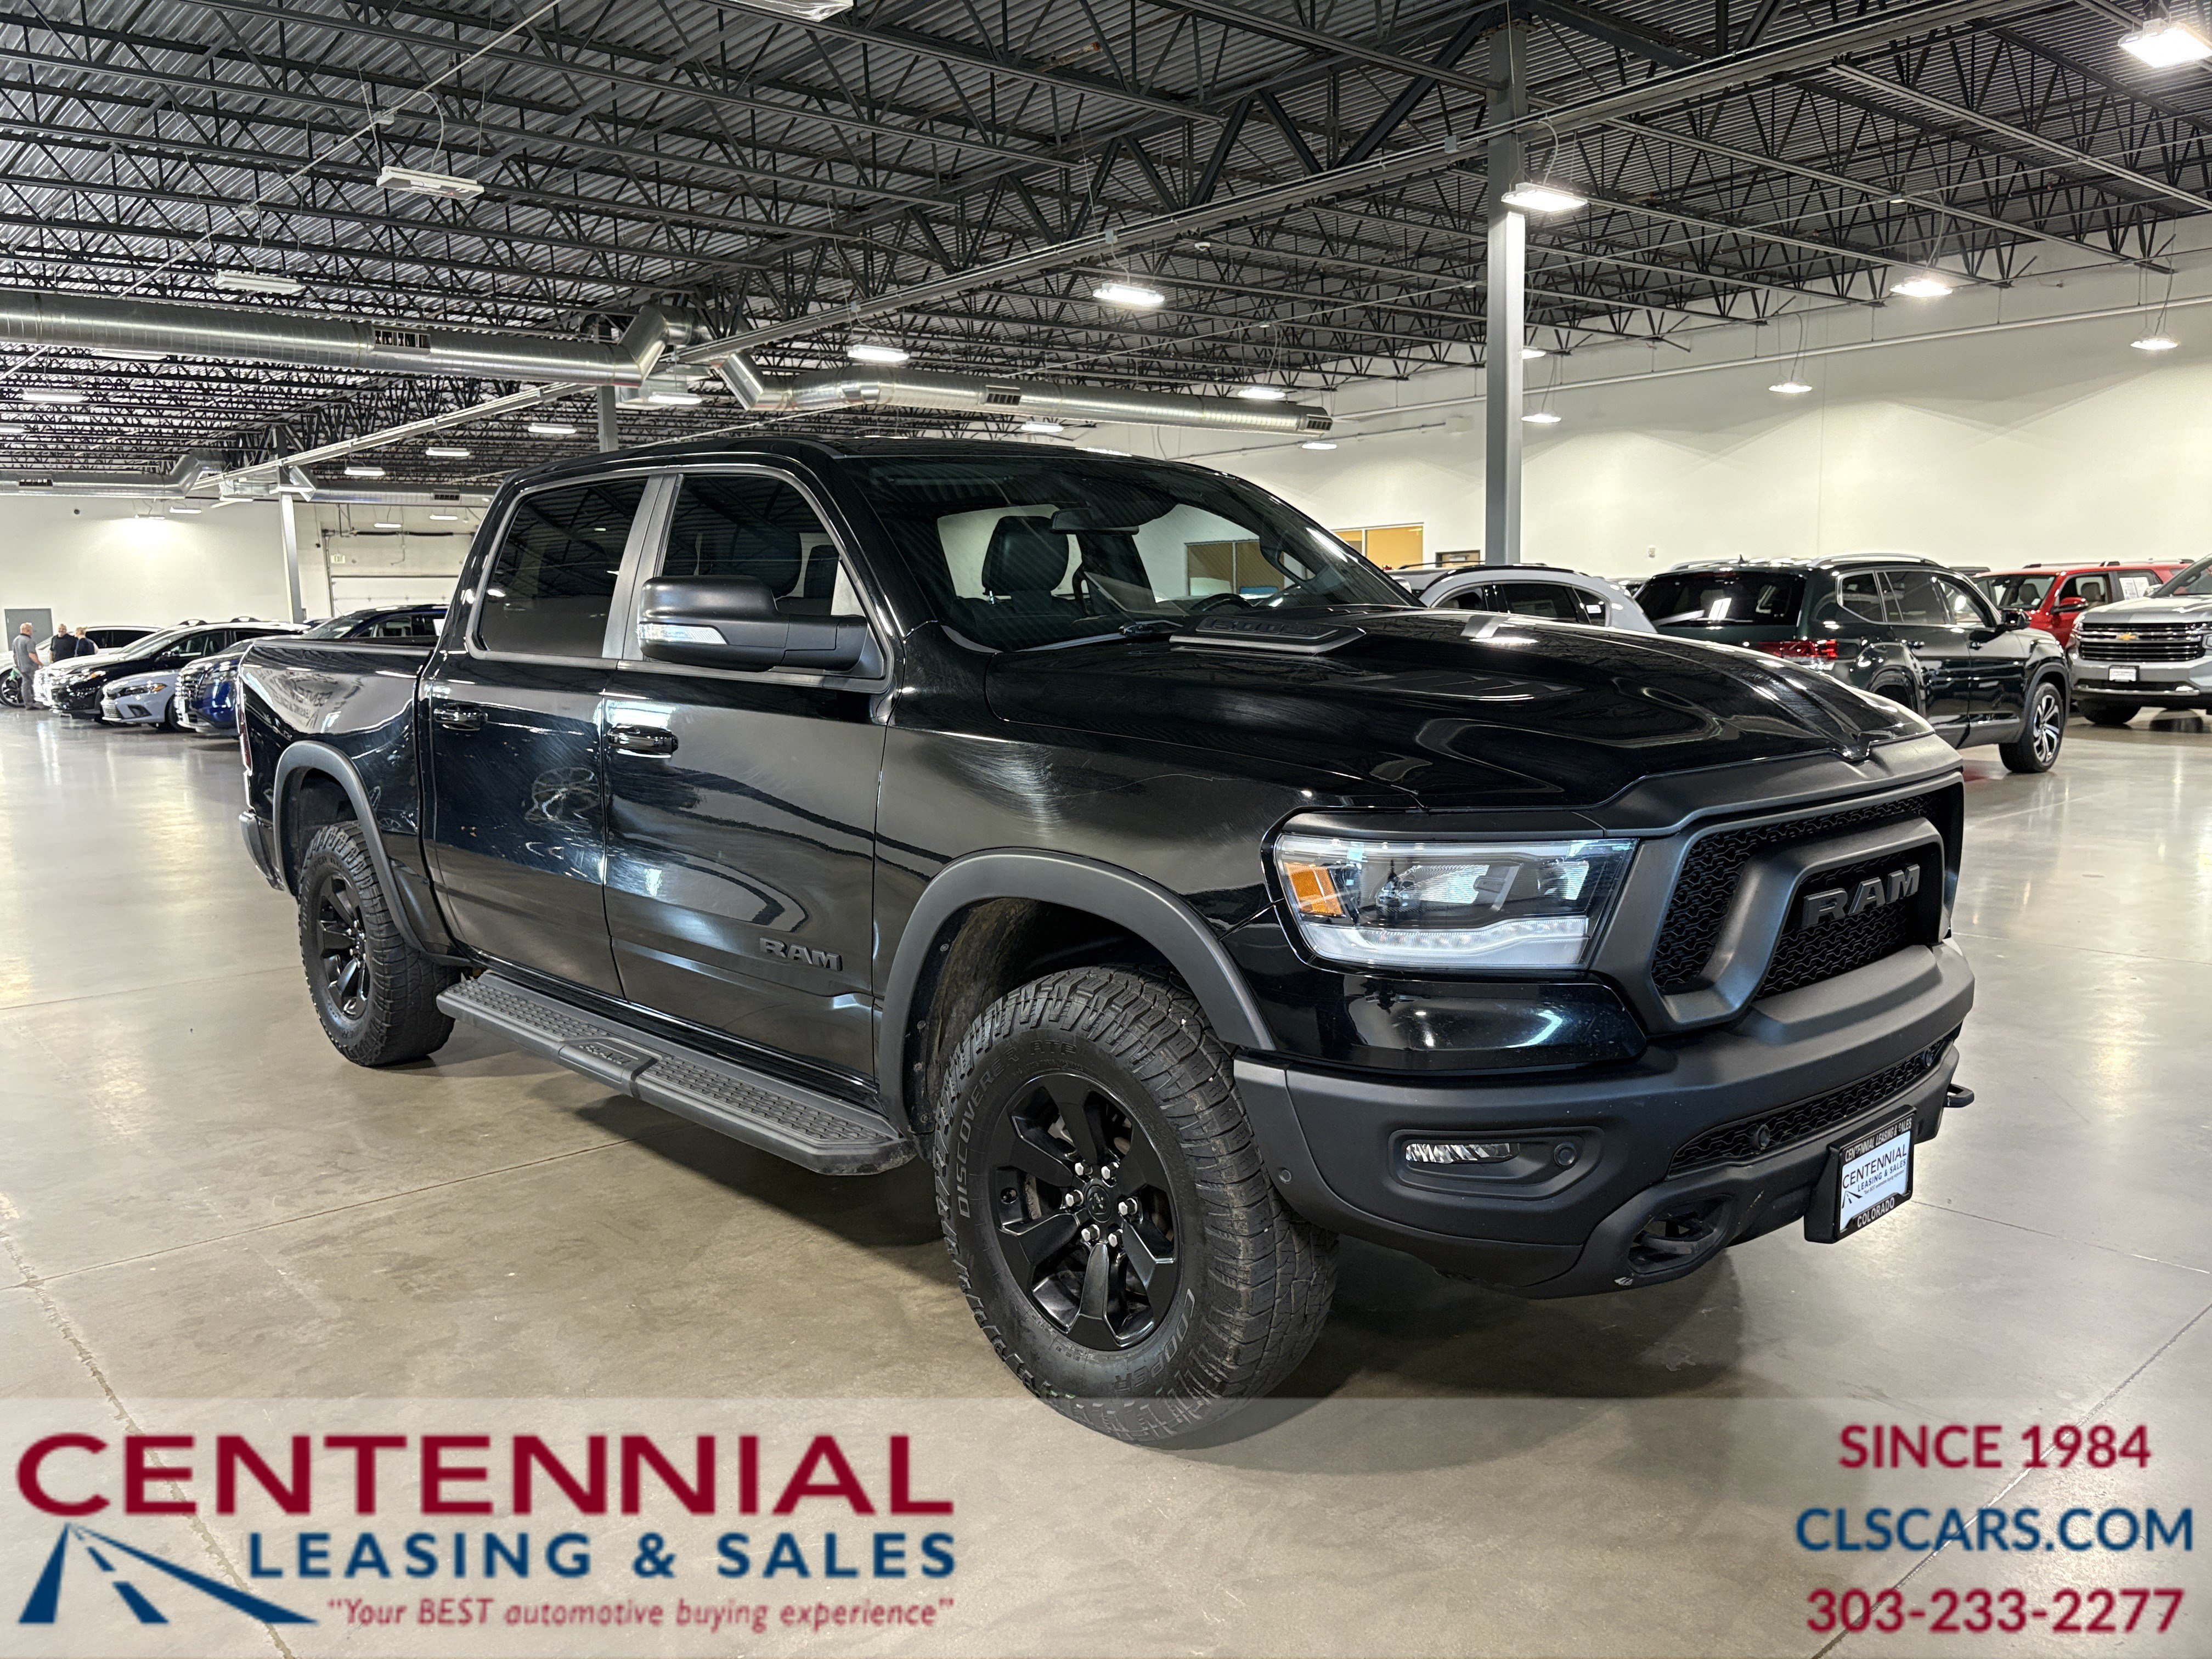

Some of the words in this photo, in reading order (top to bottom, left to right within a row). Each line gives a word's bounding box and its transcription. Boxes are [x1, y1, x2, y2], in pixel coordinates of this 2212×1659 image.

[1802, 864, 1920, 931] RAM
[760, 937, 843, 971] RAM
[956, 1046, 1019, 1218] DISCOVERER
[1030, 1040, 1077, 1056] ATP
[1845, 1136, 1875, 1163] CENTENNIAL
[1875, 1127, 1894, 1146] LEASING
[1842, 1144, 1907, 1189] CENTENNIAL
[1857, 1172, 1883, 1193] LEASING
[1884, 1169, 1888, 1177] &
[1889, 1158, 1906, 1174] SALES
[1857, 1197, 1895, 1228] COLORADO
[1114, 1288, 1196, 1393] COOPER
